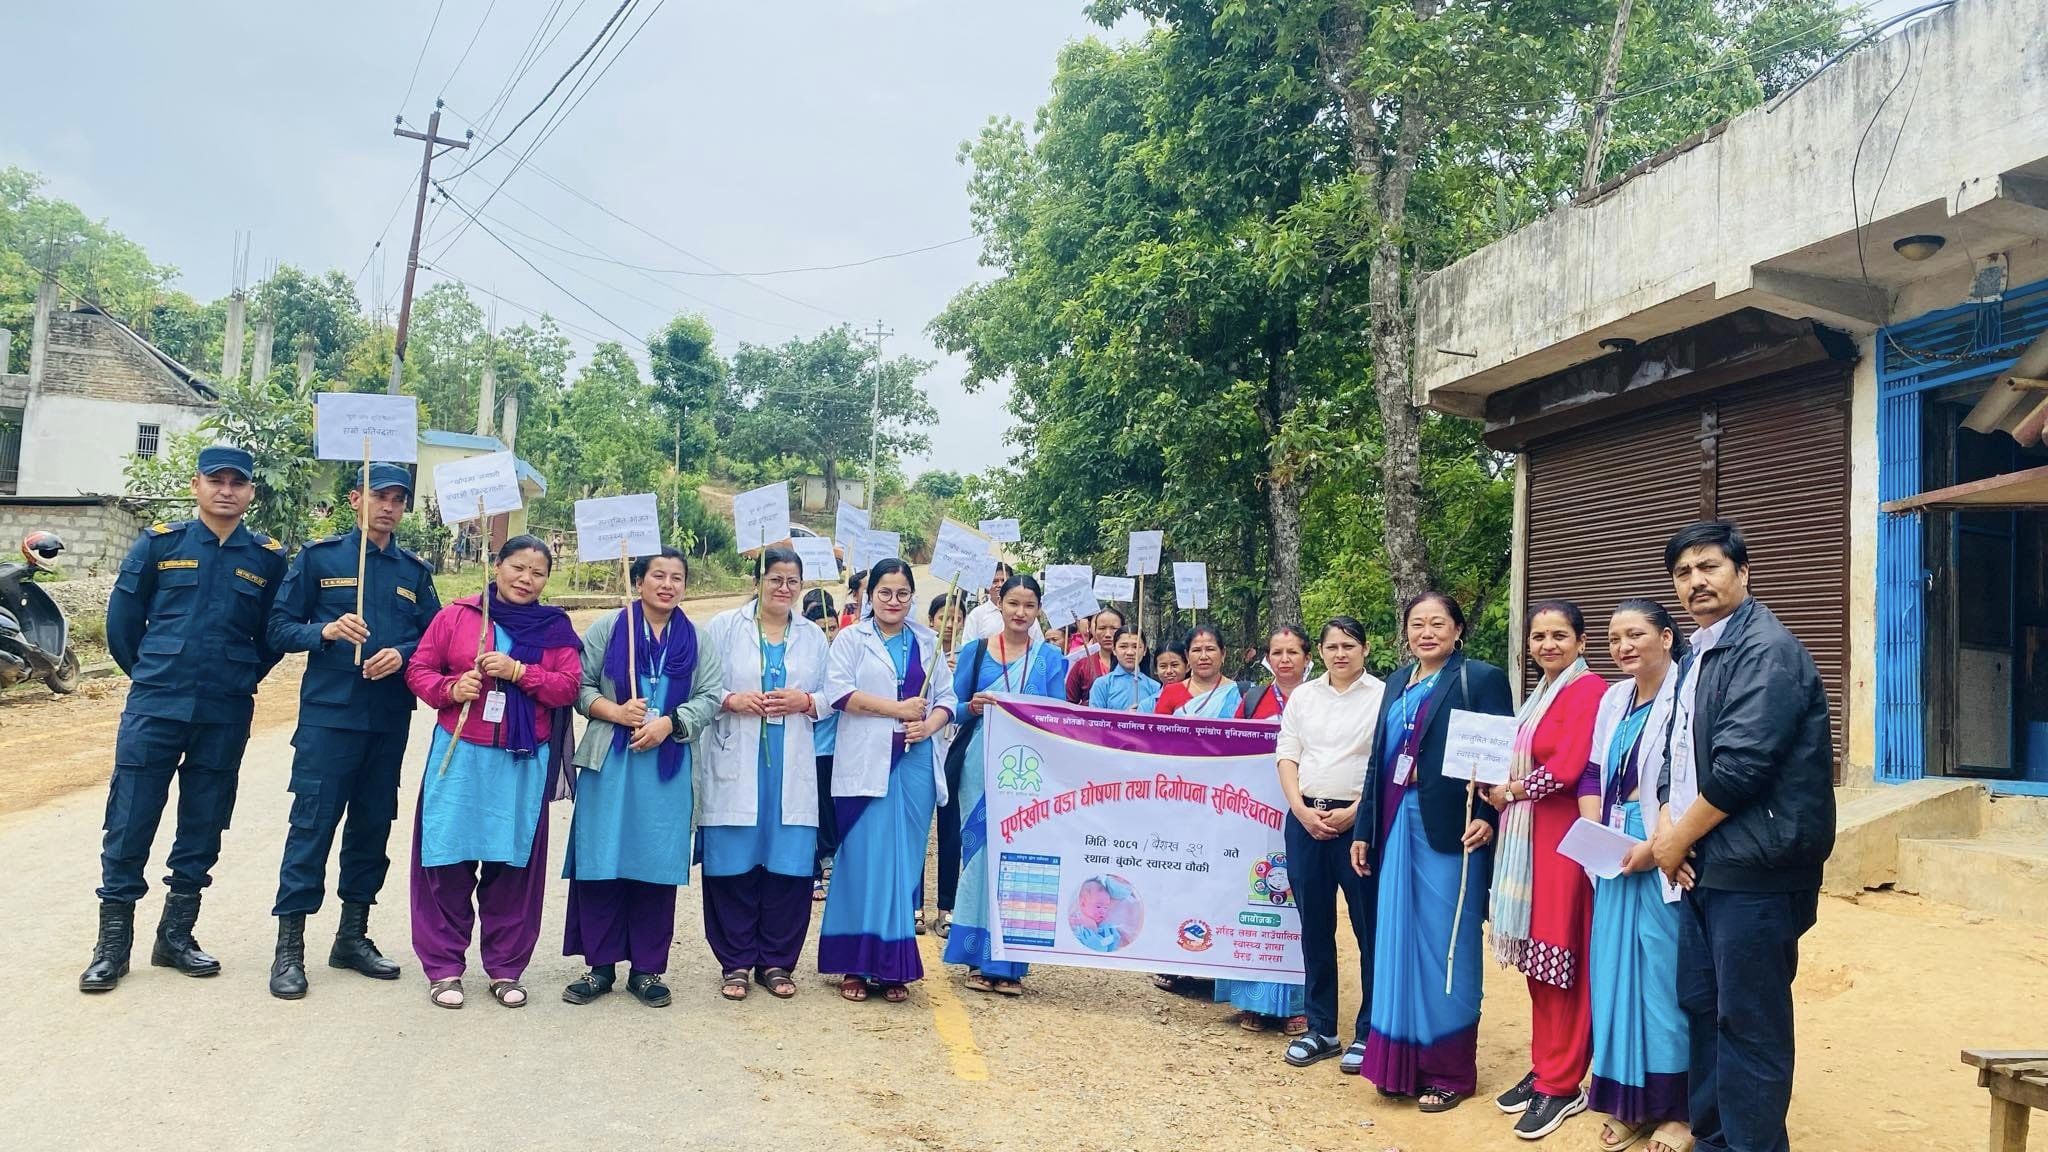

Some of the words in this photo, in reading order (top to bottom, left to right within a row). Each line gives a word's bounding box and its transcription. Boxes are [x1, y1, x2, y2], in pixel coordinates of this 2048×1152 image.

[1000, 799, 1050, 844] पूर्णखोप
[1054, 790, 1076, 816] वडा
[1080, 781, 1122, 807] घोषणा
[1125, 780, 1152, 801] तथा
[1155, 773, 1208, 804] दिगोपना
[1211, 783, 1284, 831] सुनिश्चितता
[1113, 838, 1138, 850] २०८१
[1223, 847, 1240, 859] गते
[1146, 859, 1182, 871] स्वास्थ्य
[1185, 860, 1210, 873] चौकी
